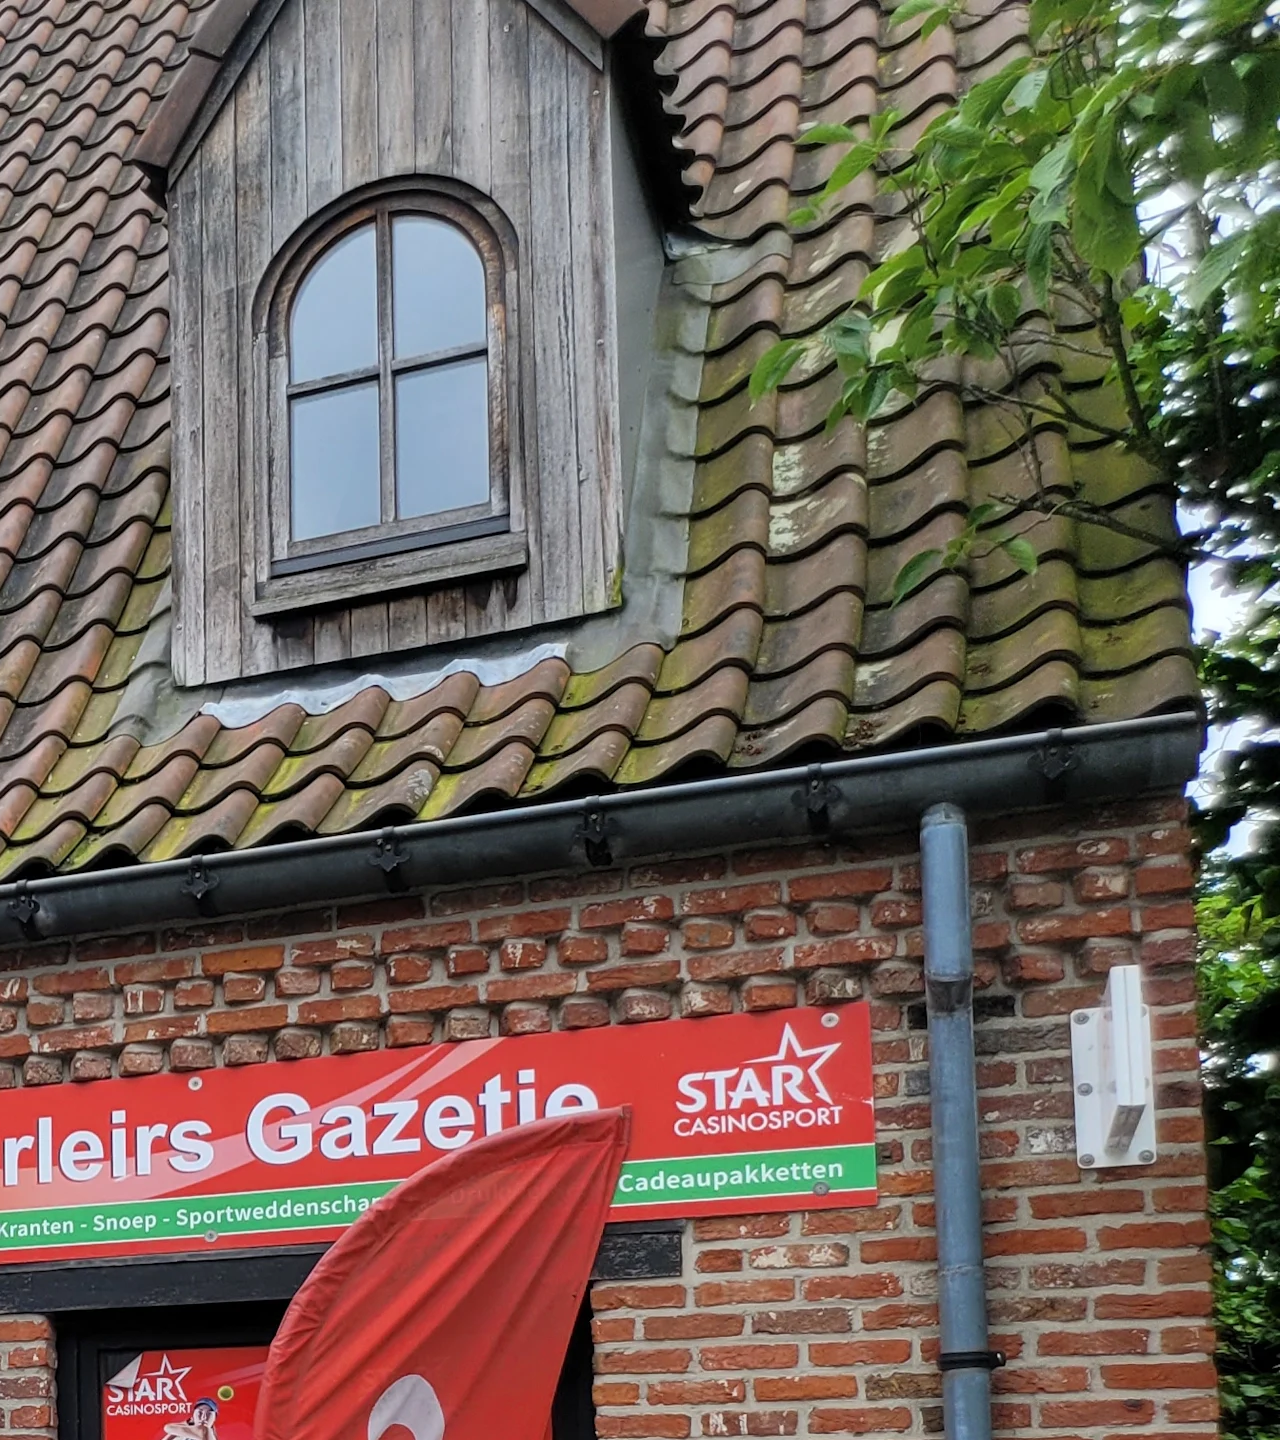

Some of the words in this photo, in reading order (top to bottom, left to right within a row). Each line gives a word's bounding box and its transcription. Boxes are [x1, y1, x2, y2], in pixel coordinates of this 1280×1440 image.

[676, 1064, 818, 1114] STAR
[674, 1105, 844, 1139] CASINOSPORT
[92, 1211, 157, 1236] Snoep
[176, 1194, 381, 1229] Sportweddenscha
[618, 1159, 844, 1194] Cadeaupakketten
[106, 1402, 193, 1416] CASINOSPORT
